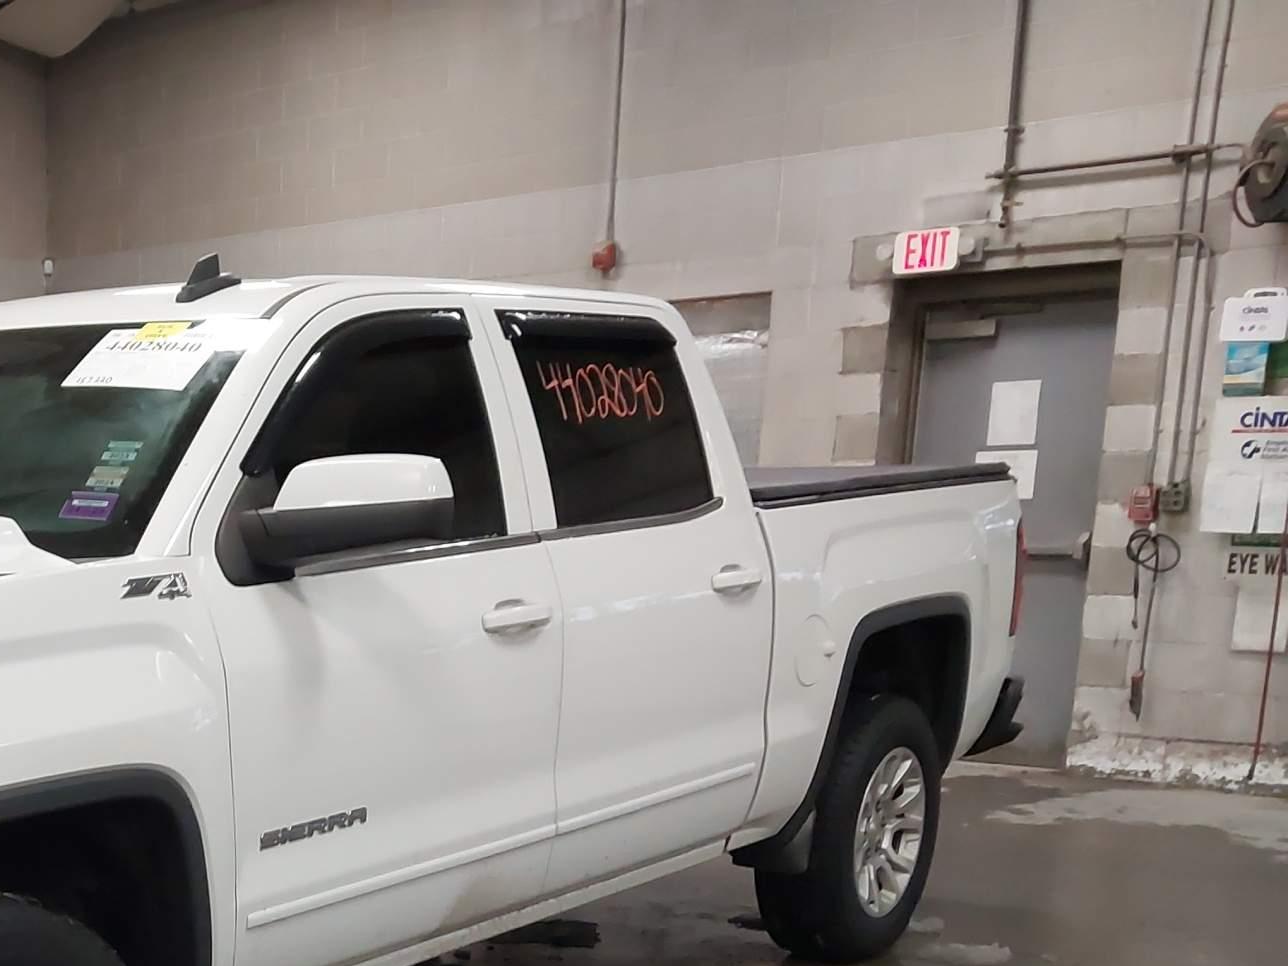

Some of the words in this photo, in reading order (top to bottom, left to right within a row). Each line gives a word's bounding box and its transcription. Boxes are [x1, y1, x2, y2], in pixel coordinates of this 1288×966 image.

[904, 231, 951, 270] EXIT
[105, 340, 203, 353] 44028040
[536, 359, 665, 425] 44028040
[1227, 553, 1259, 575] EYE
[259, 805, 368, 851] SIERRA
